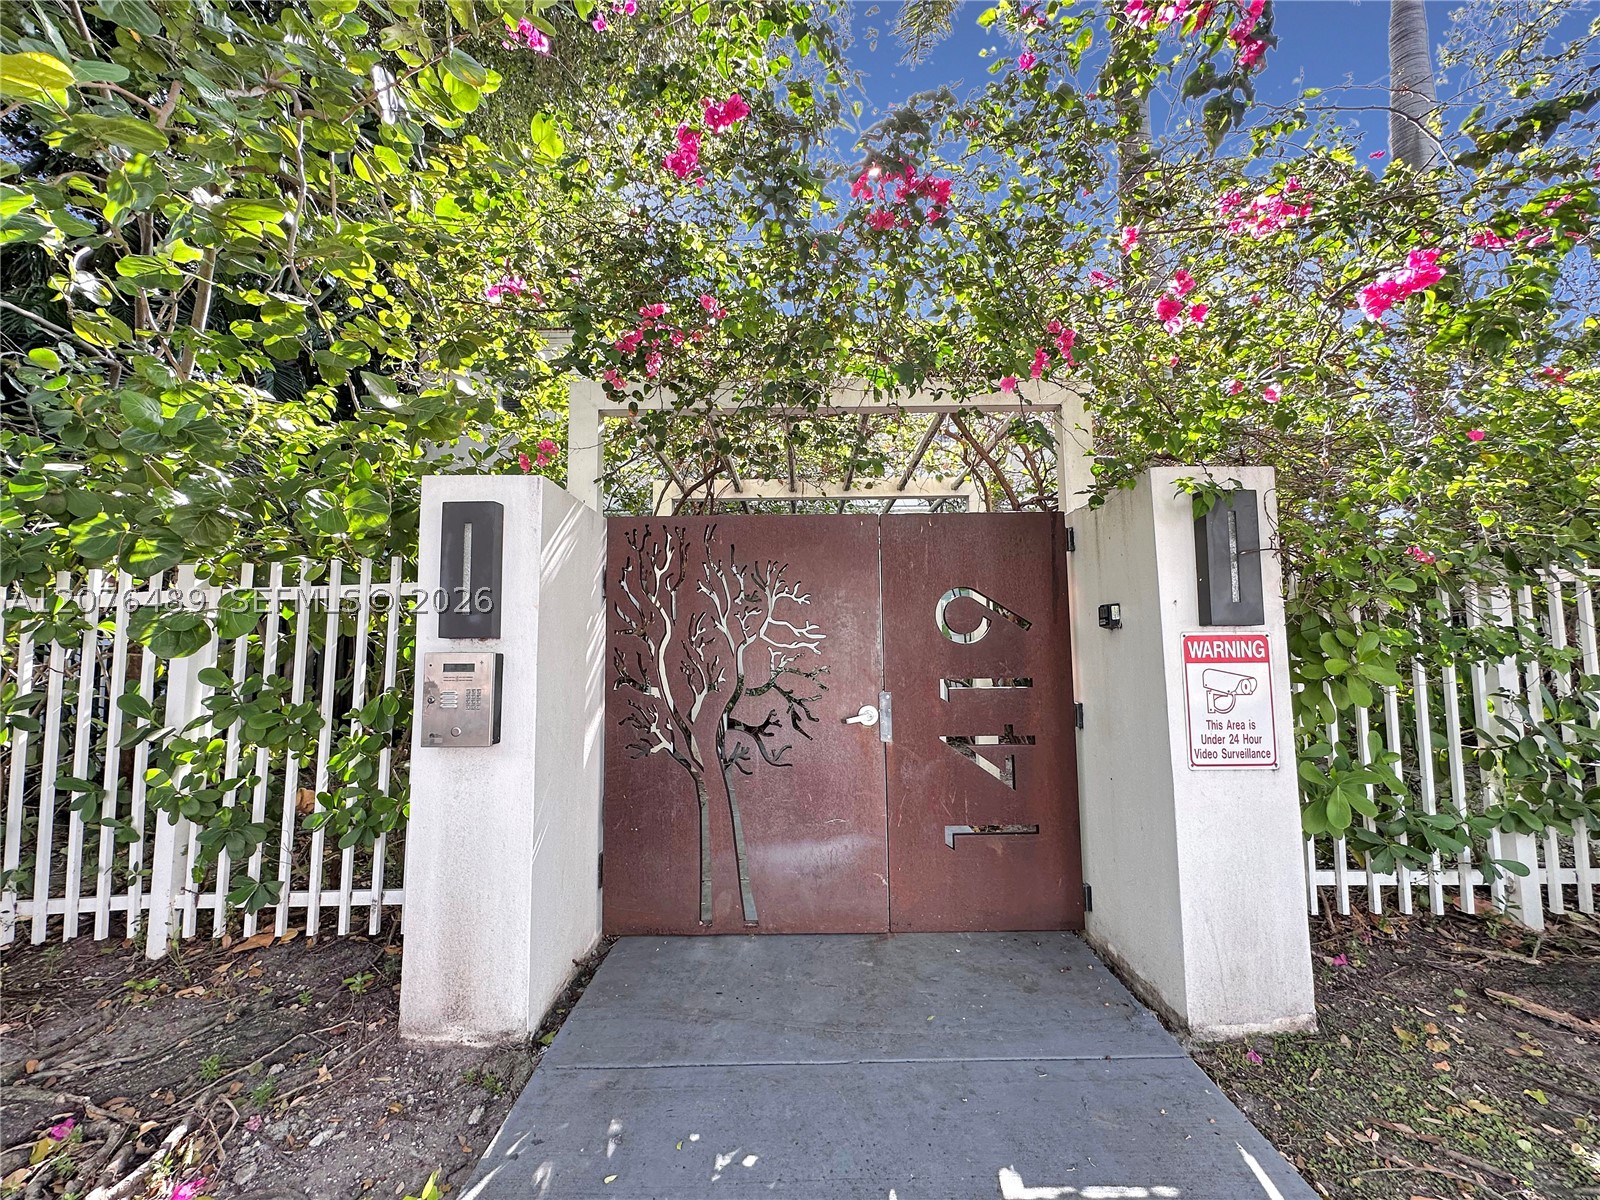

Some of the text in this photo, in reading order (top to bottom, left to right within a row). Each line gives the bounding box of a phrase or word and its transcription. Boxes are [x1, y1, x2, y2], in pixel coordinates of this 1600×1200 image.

[1187, 639, 1266, 659] WARNING
[935, 586, 1040, 851] 1419
[1205, 719, 1256, 731] This Area is
[1200, 734, 1263, 745] Under 24 Hour
[1193, 748, 1271, 760] Video Surveillance
